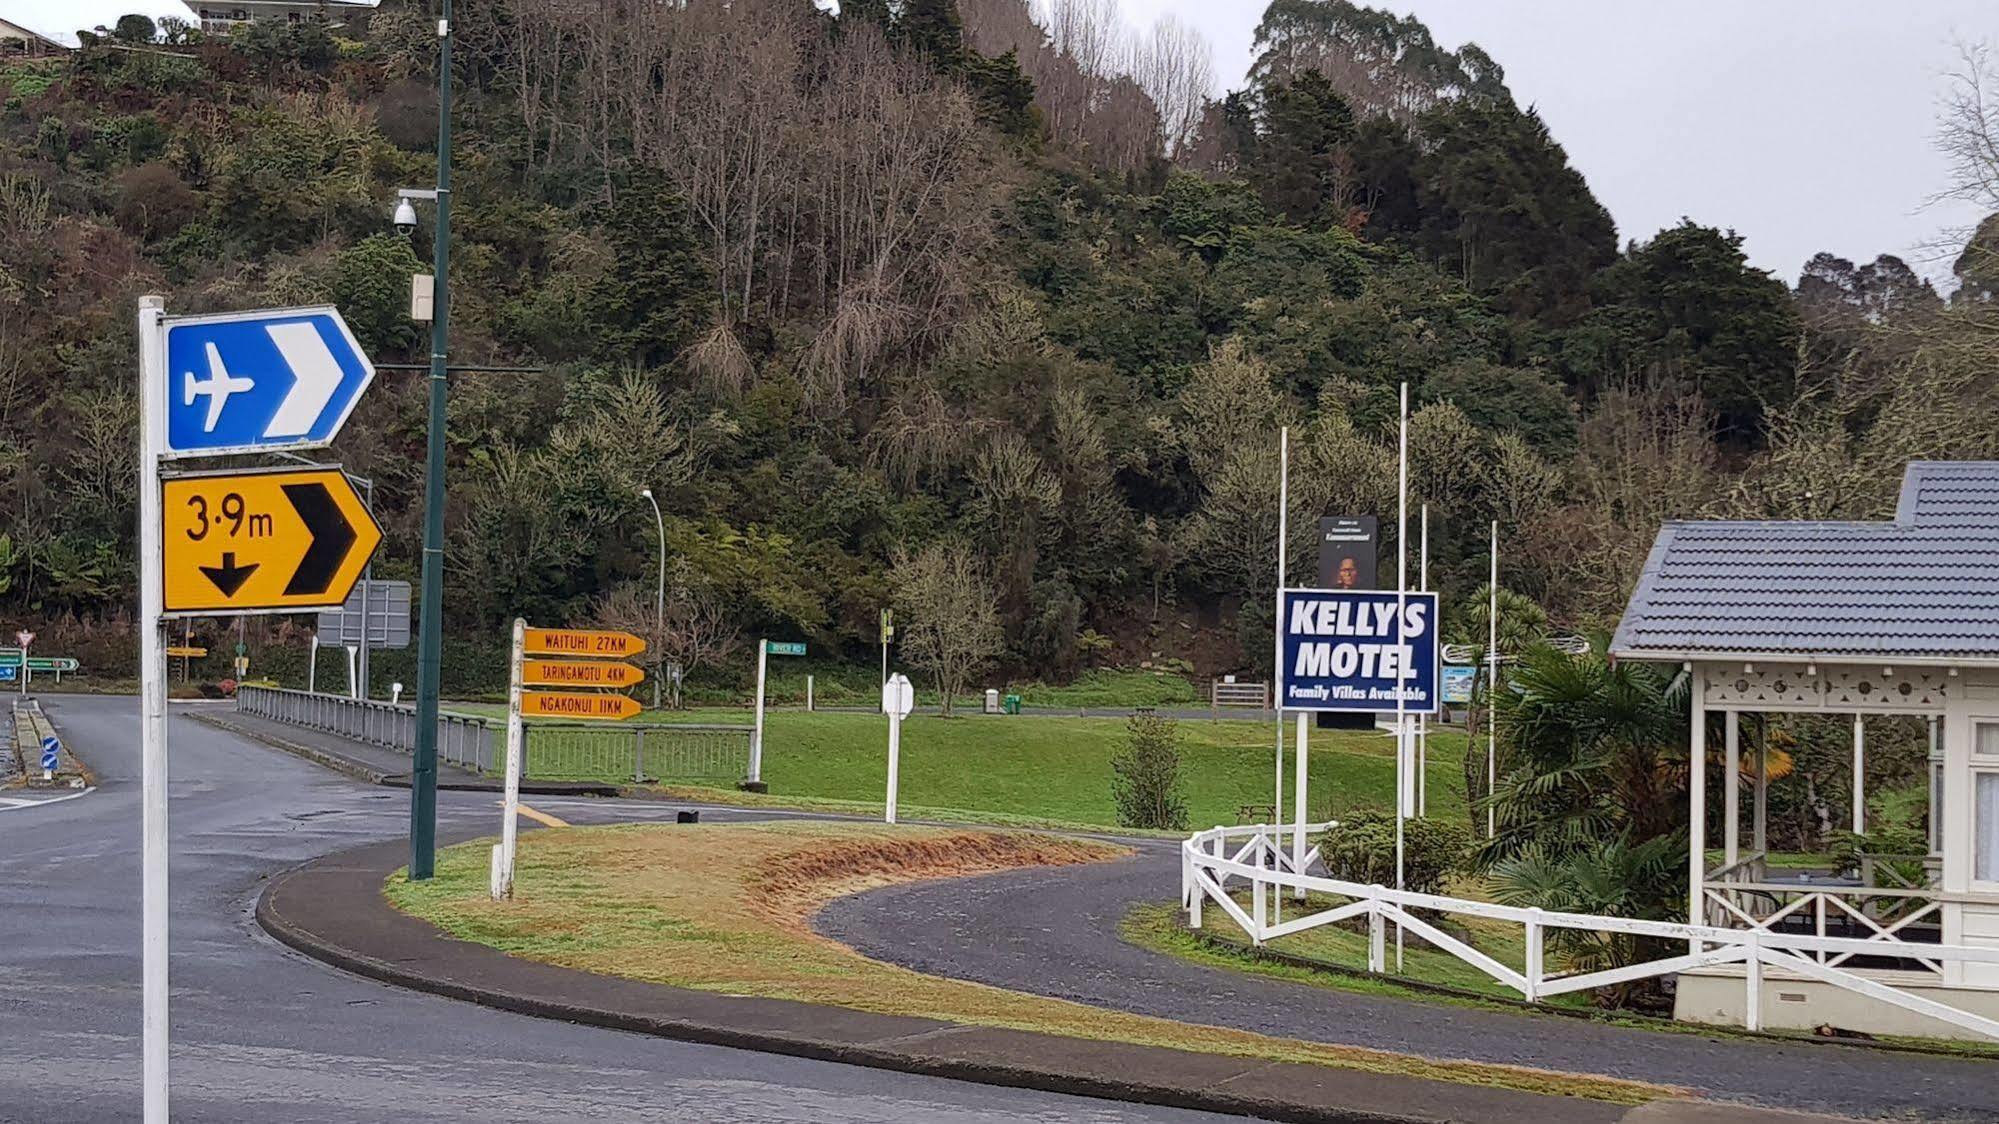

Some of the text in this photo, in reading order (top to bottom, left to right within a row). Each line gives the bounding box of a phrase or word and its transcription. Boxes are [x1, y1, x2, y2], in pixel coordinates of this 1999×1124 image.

[1289, 600, 1427, 638] KELLYS
[545, 634, 626, 652] WAITUHI 27KM
[1294, 642, 1417, 679] MOTEL
[542, 665, 625, 681] TARINGAMOTU 4KM
[1289, 684, 1427, 701] Family Villas Avaiable
[540, 697, 622, 713] NGAKONUI 11KM
